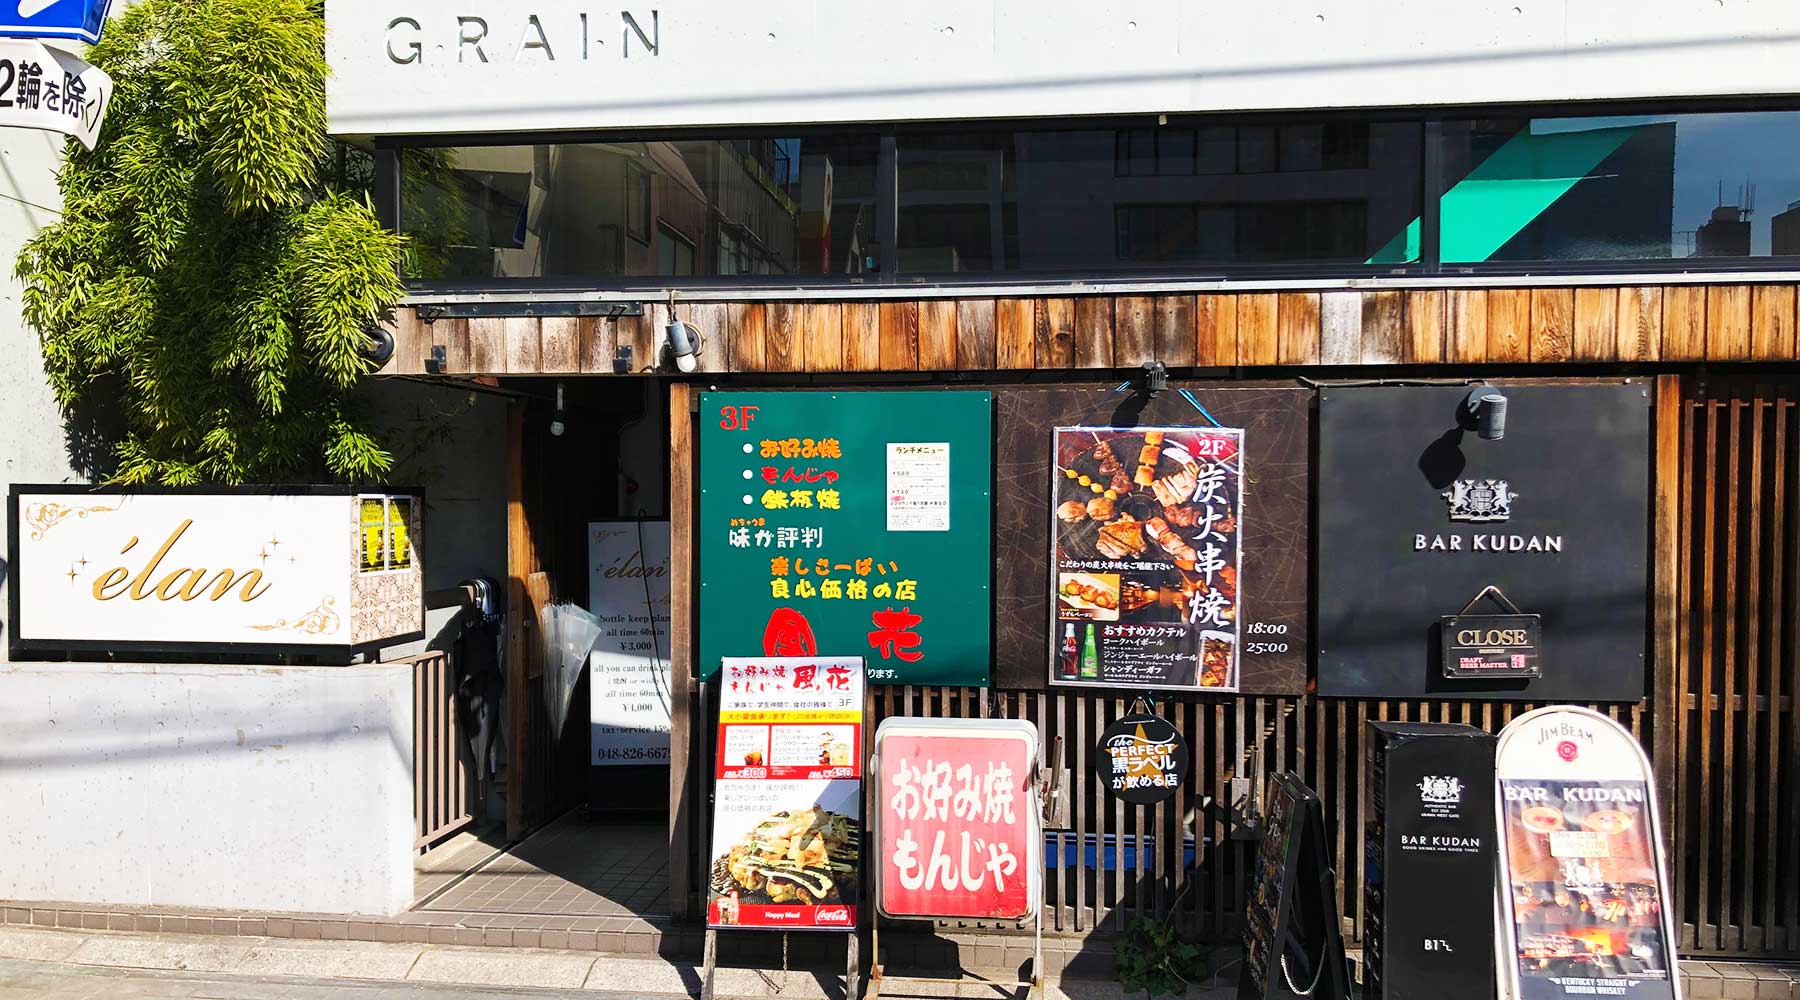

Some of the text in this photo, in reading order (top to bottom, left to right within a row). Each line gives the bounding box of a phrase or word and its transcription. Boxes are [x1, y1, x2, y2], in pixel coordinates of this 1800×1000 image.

[386, 10, 660, 66] GRAIN
[719, 405, 760, 431] 3F
[760, 438, 842, 458] お好み焼
[896, 446, 944, 455] ランチメニュー
[1199, 439, 1227, 456] 2F
[761, 466, 839, 485] もんじゃ
[761, 489, 840, 509] 鉄板焼
[729, 526, 823, 549] 味が評判
[1190, 462, 1232, 629] 炭火串焼
[1415, 534, 1562, 552] BAR KUDAN
[92, 518, 272, 603] élan
[604, 551, 667, 579] élan
[770, 578, 917, 601] 良心価格の店
[628, 614, 649, 624] keep
[606, 628, 617, 637] all
[620, 628, 640, 637] time
[1104, 625, 1187, 638] おすすめカクテル
[1246, 622, 1288, 635] 18:00
[620, 641, 652, 651] ¥3,000
[1457, 629, 1527, 646] CLOSE
[1246, 642, 1288, 654] 25:00
[730, 665, 787, 678] お好み焼
[793, 664, 853, 691] 風花
[838, 698, 853, 707] 3F
[1114, 737, 1134, 747] the
[1538, 722, 1594, 745] JIM BEAM
[1110, 744, 1175, 758] PERFECT
[1112, 755, 1176, 774] 黒ラベル
[1112, 773, 1178, 789] が飲める店
[890, 758, 1016, 825] お好み焼
[1504, 787, 1642, 802] BAR KUDAN
[1401, 835, 1480, 847] BAR KUDAN
[891, 829, 1018, 893] もんじゃ
[765, 911, 784, 919] Happy
[1424, 939, 1438, 951] B1
